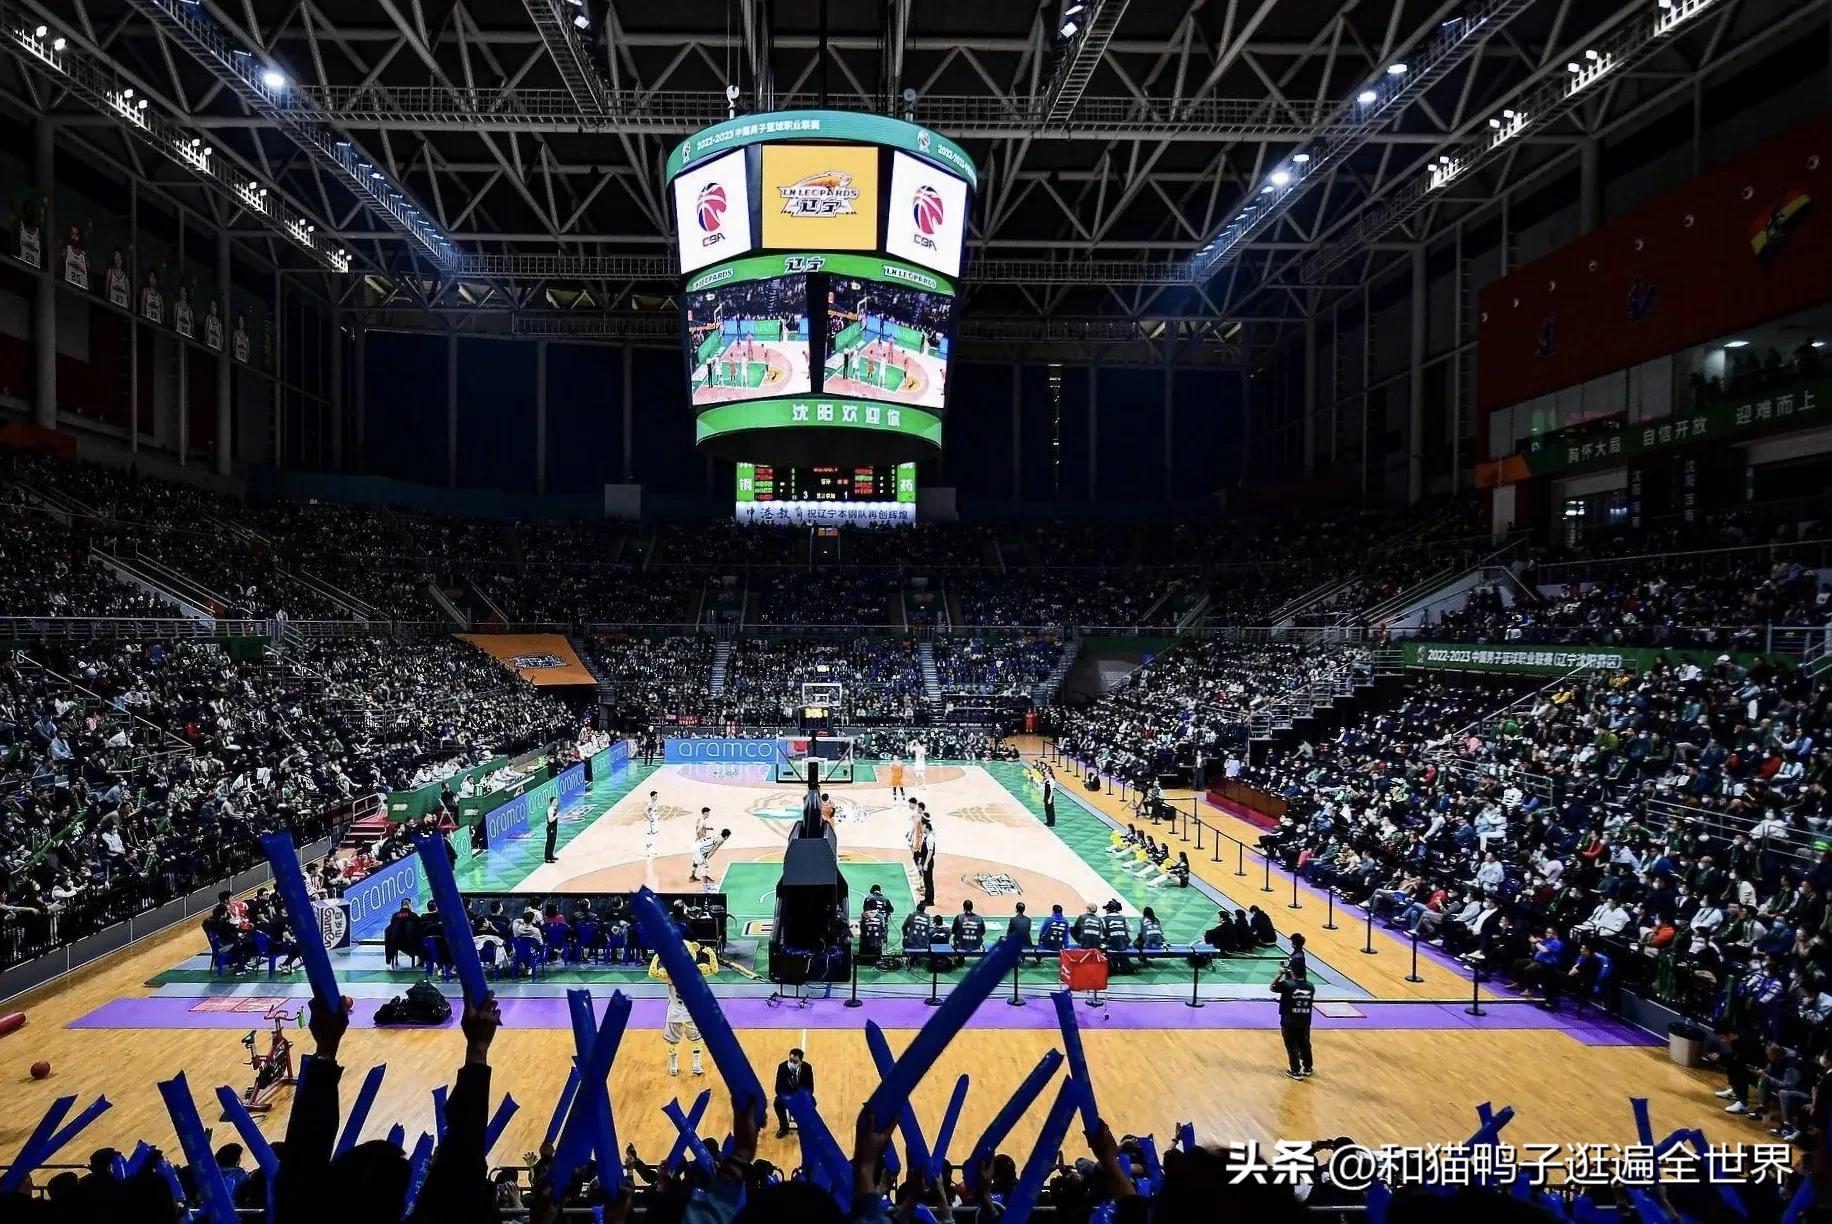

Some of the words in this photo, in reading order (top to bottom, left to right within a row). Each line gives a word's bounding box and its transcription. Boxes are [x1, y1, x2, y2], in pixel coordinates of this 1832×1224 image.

[799, 188, 857, 197] LEOPARDS
[702, 232, 726, 247] CBA
[913, 234, 937, 251] CBA
[1642, 415, 1708, 447] 自信开放
[1735, 389, 1816, 426] 迎难而上
[1427, 649, 1471, 663] 2022-2023
[678, 740, 773, 758] aramco
[488, 802, 526, 838] aramco
[350, 866, 415, 923] aramco
